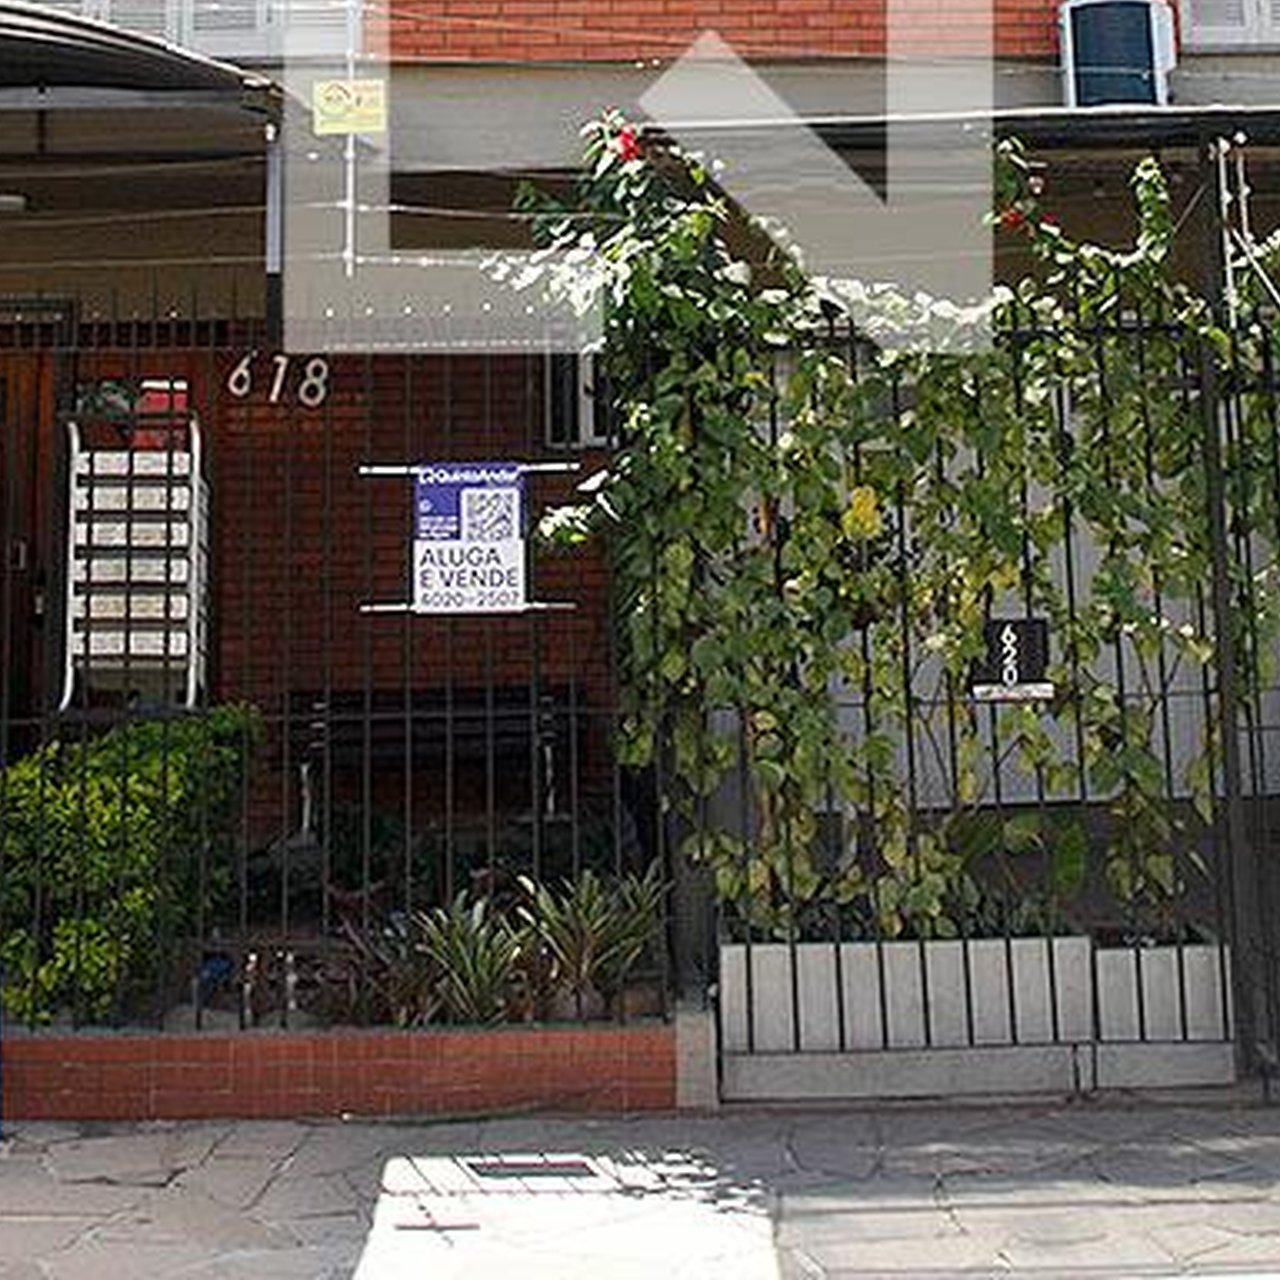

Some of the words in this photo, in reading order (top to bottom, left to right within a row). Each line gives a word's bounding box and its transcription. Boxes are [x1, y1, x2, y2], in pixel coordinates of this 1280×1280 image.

[228, 351, 328, 407] 618
[419, 546, 501, 568] ALUGA
[420, 568, 433, 589] E
[439, 566, 519, 588] VENDE
[999, 623, 1017, 687] 620
